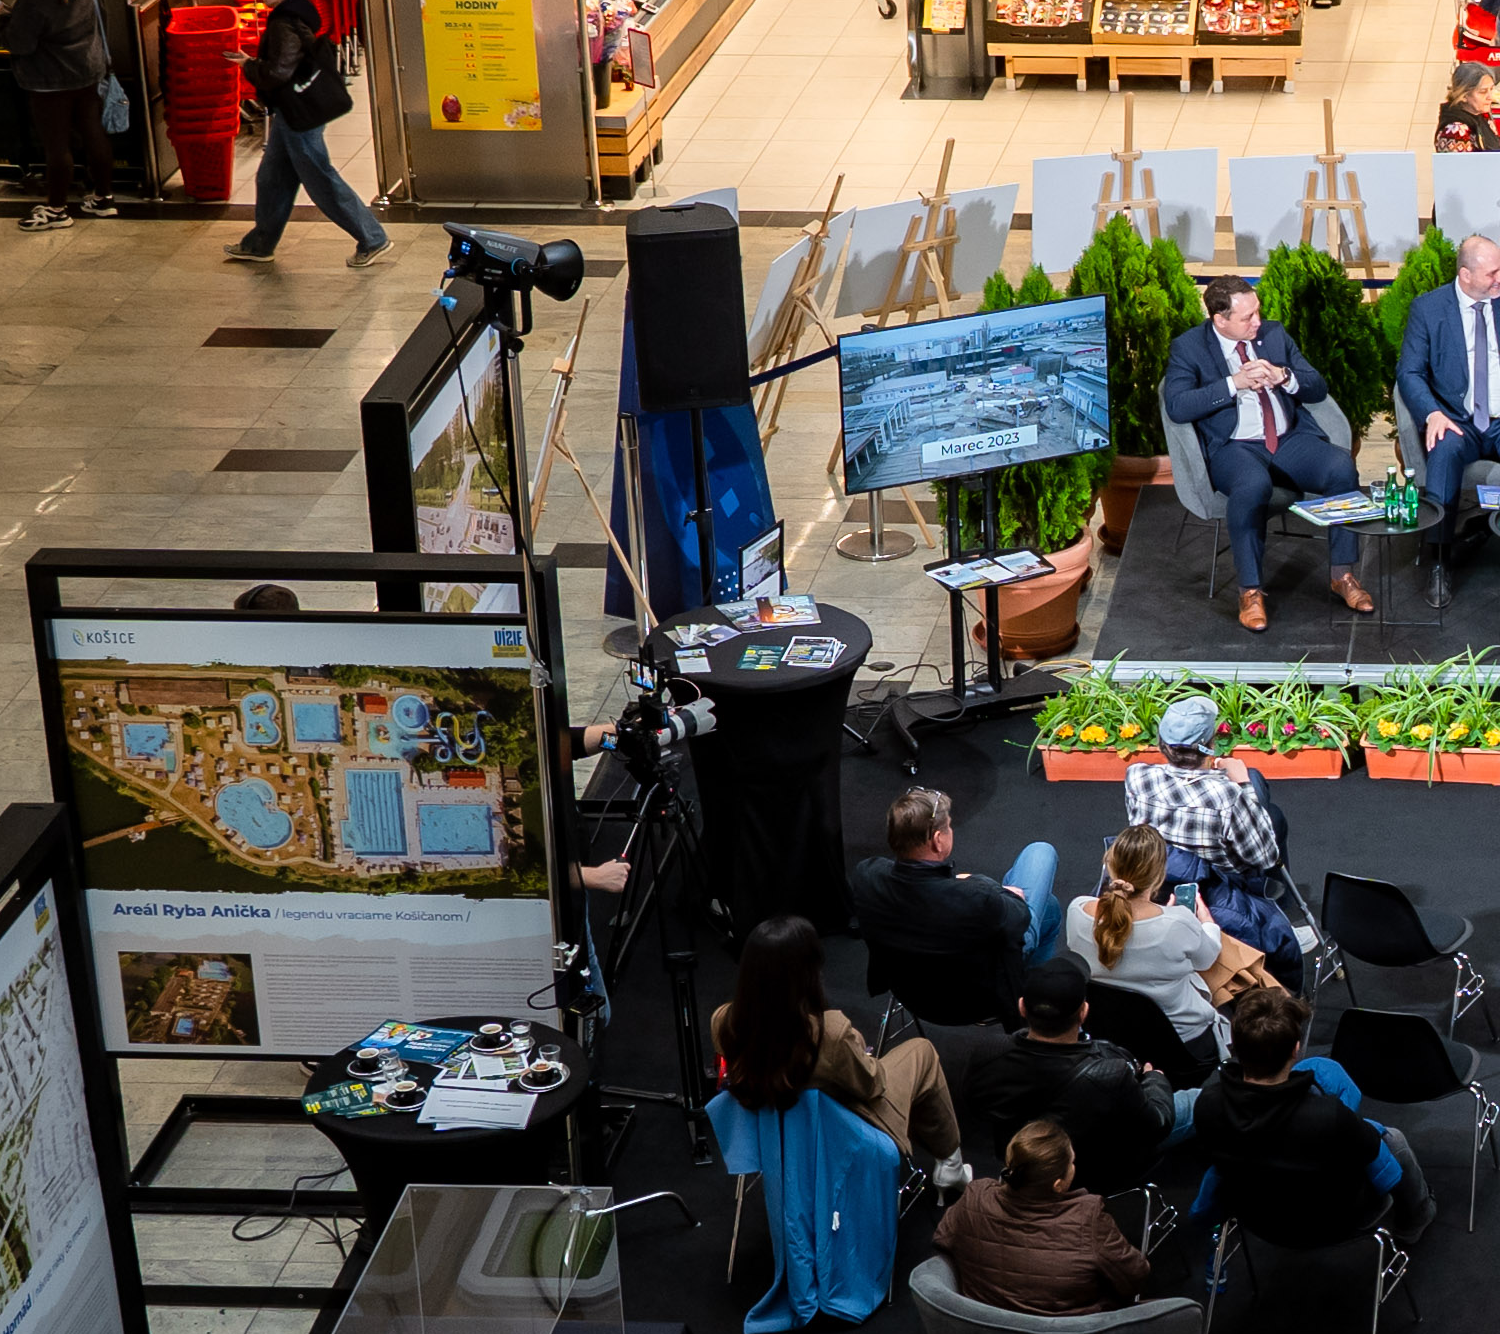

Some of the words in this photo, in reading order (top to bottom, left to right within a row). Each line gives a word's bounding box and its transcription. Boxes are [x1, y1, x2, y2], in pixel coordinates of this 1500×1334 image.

[456, 1, 498, 10] HODINY
[941, 442, 984, 456] Marec
[987, 432, 1019, 448] 2023
[86, 630, 136, 646] KOŠICE
[113, 901, 159, 918] Areál
[162, 903, 207, 922] Ryba
[211, 904, 272, 919] Anička
[282, 909, 331, 923] legendu
[333, 910, 392, 921] vraciame
[395, 910, 463, 923] Košičanom
